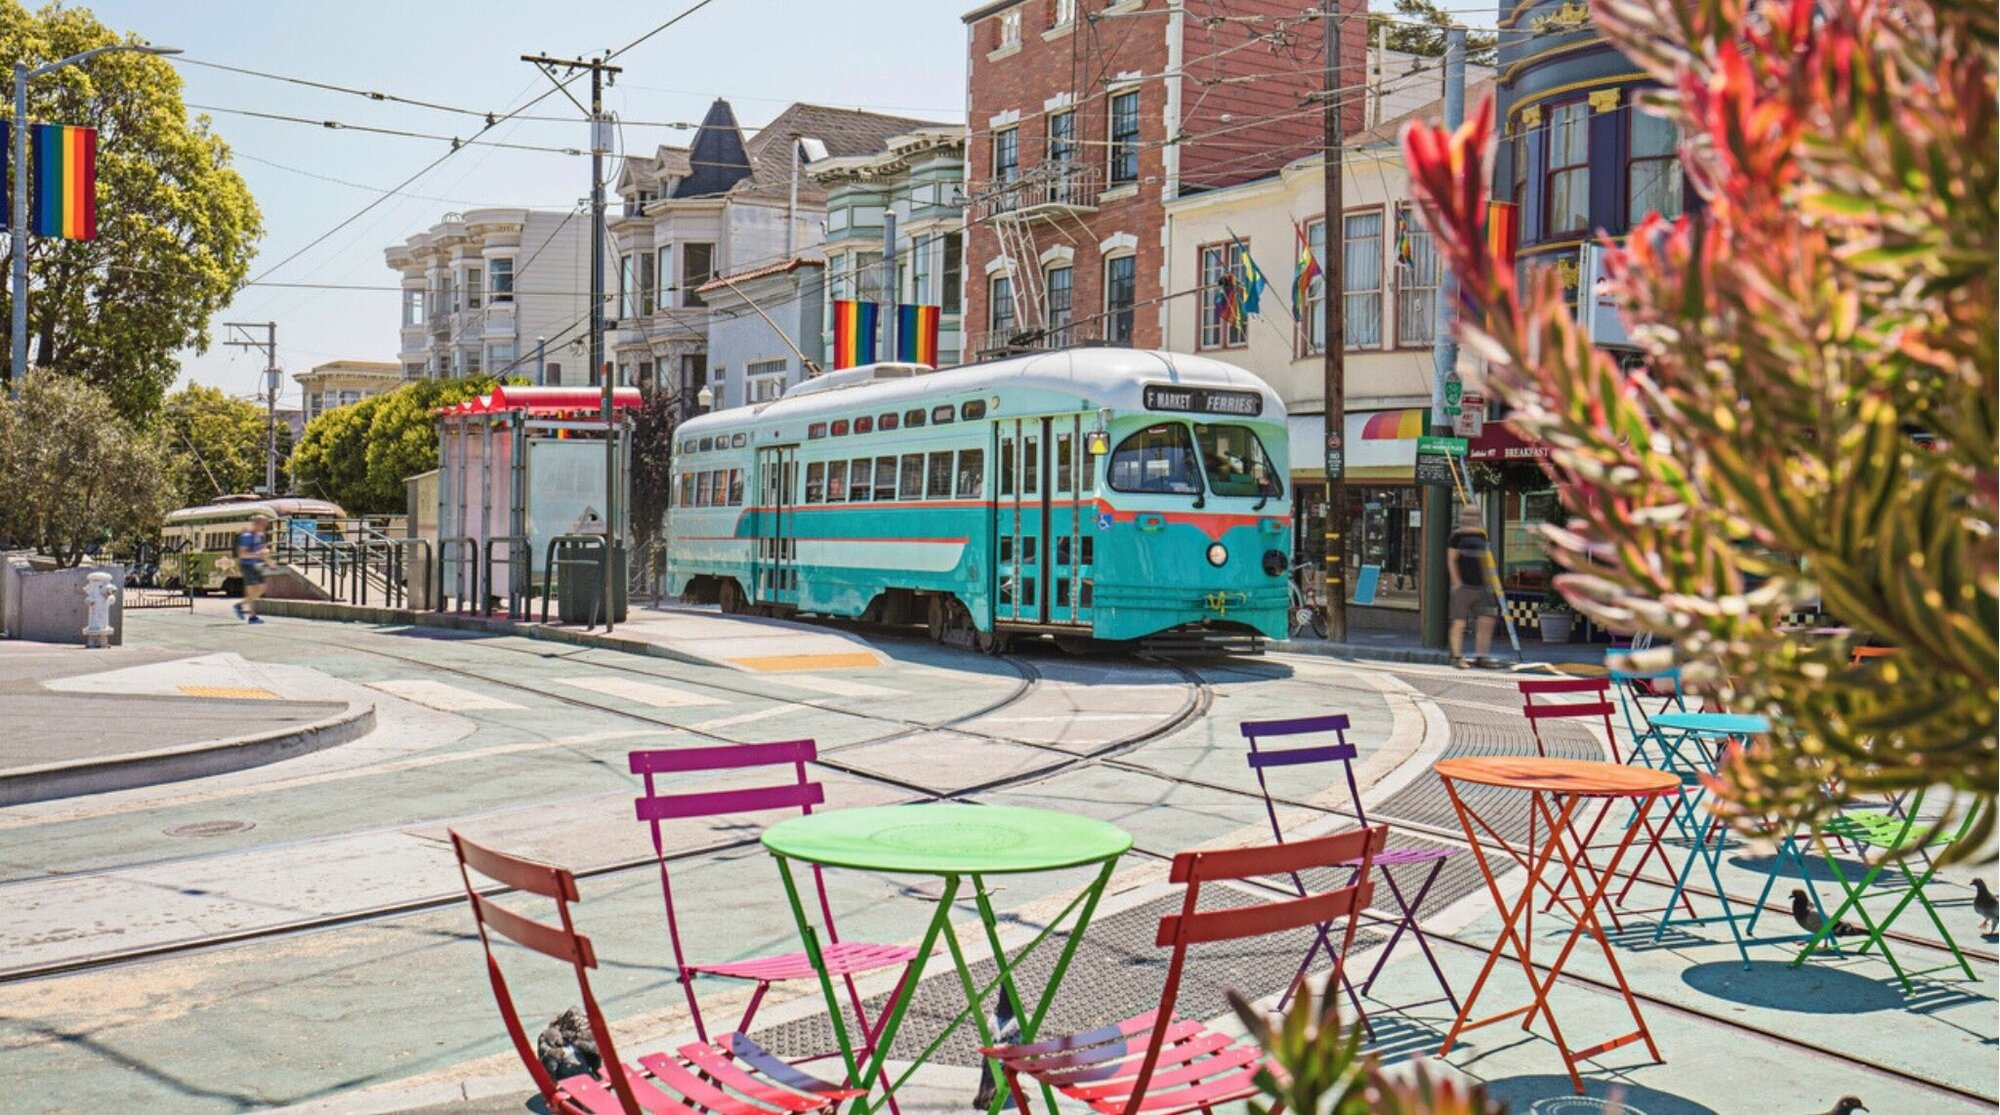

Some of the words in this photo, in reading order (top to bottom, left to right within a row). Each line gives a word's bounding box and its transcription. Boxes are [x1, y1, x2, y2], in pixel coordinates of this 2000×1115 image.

[1147, 392, 1154, 408] F
[1157, 392, 1191, 409] MARKET
[1206, 395, 1253, 413] FERRIES
[1504, 447, 1548, 458] BREAKFAST
